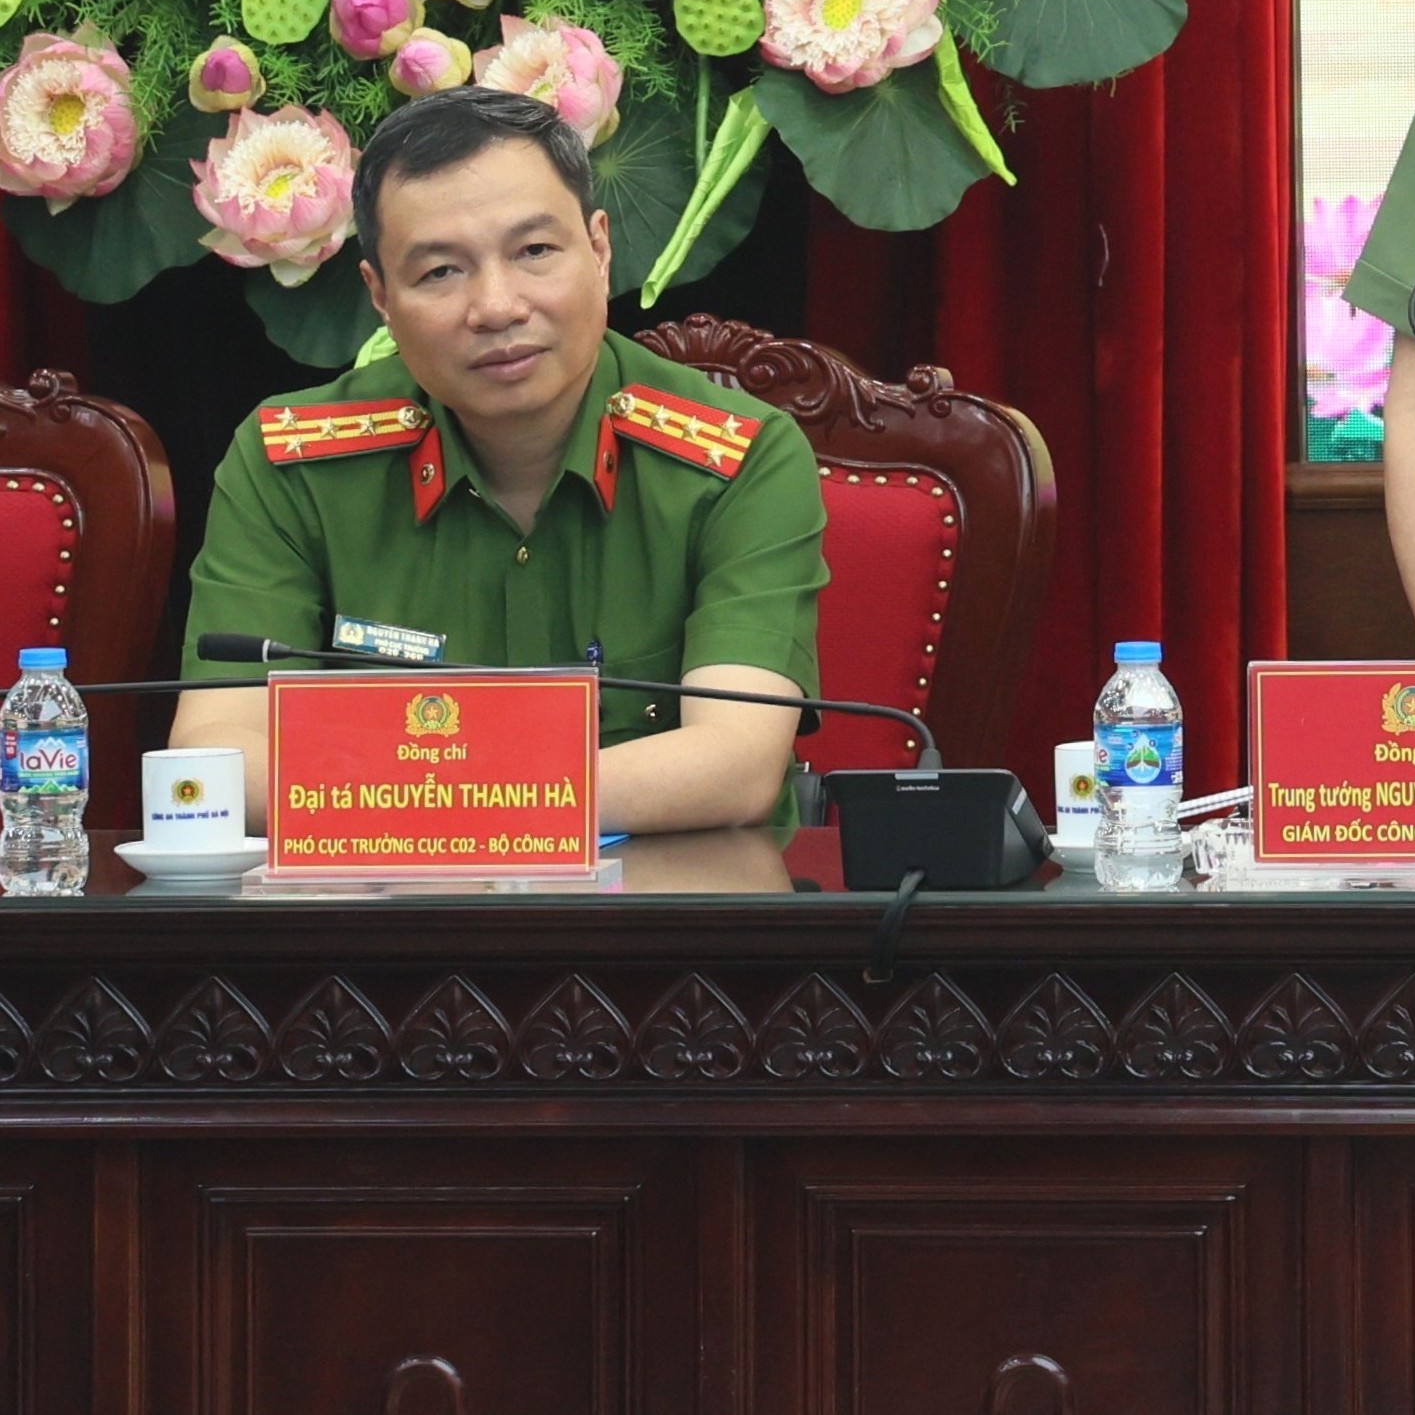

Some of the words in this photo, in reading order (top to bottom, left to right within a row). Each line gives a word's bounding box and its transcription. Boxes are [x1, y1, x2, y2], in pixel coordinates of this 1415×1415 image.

[396, 742, 440, 764] Đồng
[444, 742, 467, 761] chí
[288, 783, 326, 814] Đại
[330, 783, 353, 809] tá
[359, 772, 453, 809] NGUYỄN
[458, 783, 538, 808] THANH
[544, 776, 577, 808] HÀ
[1268, 782, 1316, 813] Trung
[1318, 780, 1373, 813] tướng
[1282, 821, 1331, 843] GIÁM
[1334, 819, 1373, 842] ĐỐC
[283, 835, 316, 855] PHÓ
[317, 838, 348, 857] CỤC
[350, 833, 413, 854] TRƯỞNG
[417, 837, 447, 856] CỤC
[449, 837, 477, 854] C02
[488, 833, 509, 856] BỘ
[512, 833, 555, 853] CÔNG
[557, 836, 580, 853] AN
